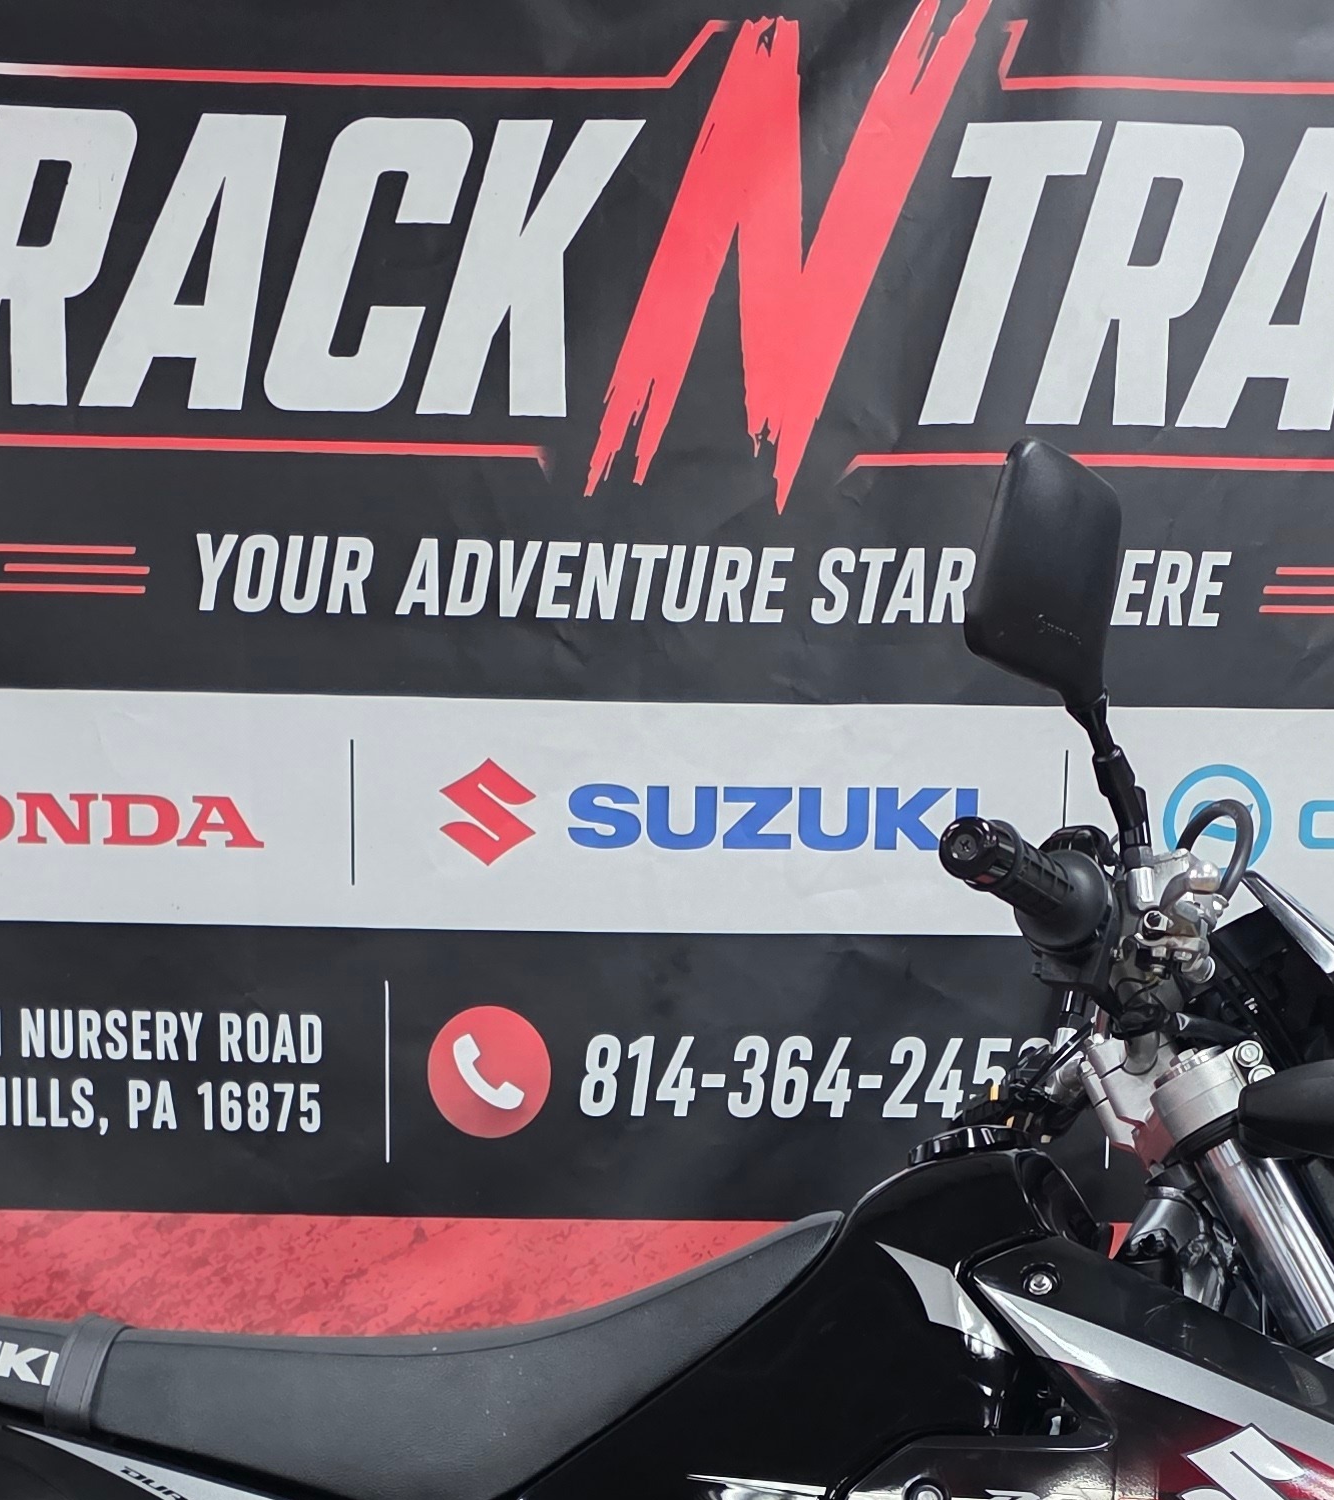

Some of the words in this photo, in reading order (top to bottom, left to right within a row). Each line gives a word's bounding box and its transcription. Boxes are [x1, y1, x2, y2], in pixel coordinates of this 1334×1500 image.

[586, 0, 992, 515] N
[196, 533, 373, 615] YOUR
[395, 538, 795, 624] ADVENTURE
[810, 547, 977, 625] STAR
[1109, 549, 1233, 627] ERE
[20, 1008, 203, 1062] NURSERY
[219, 1013, 323, 1064] ROAD
[578, 1033, 1051, 1119] 814-364-245
[128, 1080, 178, 1130] PA
[197, 1082, 321, 1133] 16875
